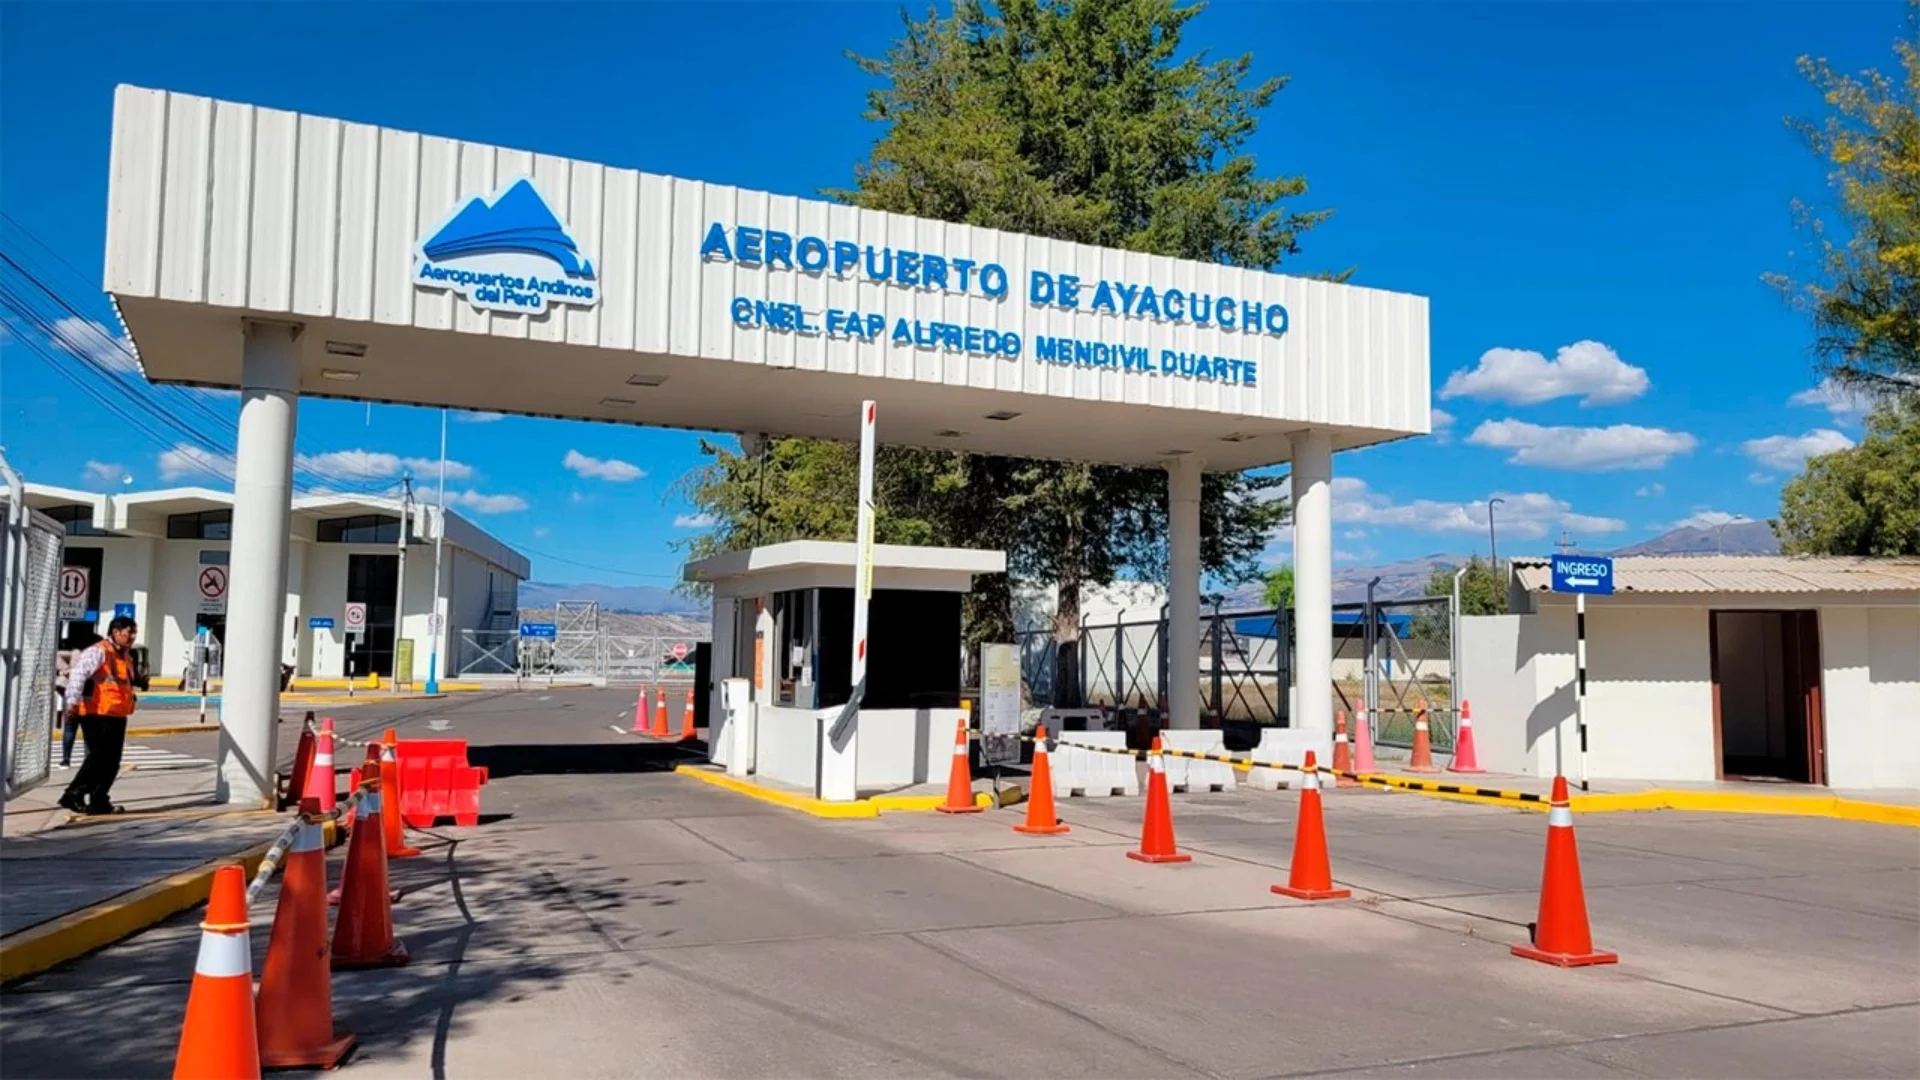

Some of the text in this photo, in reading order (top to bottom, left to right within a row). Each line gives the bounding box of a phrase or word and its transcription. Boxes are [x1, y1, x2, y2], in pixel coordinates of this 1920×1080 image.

[419, 263, 594, 299] Aeropuertos Andinos
[700, 222, 1289, 334] AEROPUERTO DE AYACUCHO
[475, 286, 541, 308] del Perú
[731, 296, 1258, 384] CNEL. FAP ALFREDO MENDIVIL DUARTE
[1556, 560, 1608, 577] INGRESO
